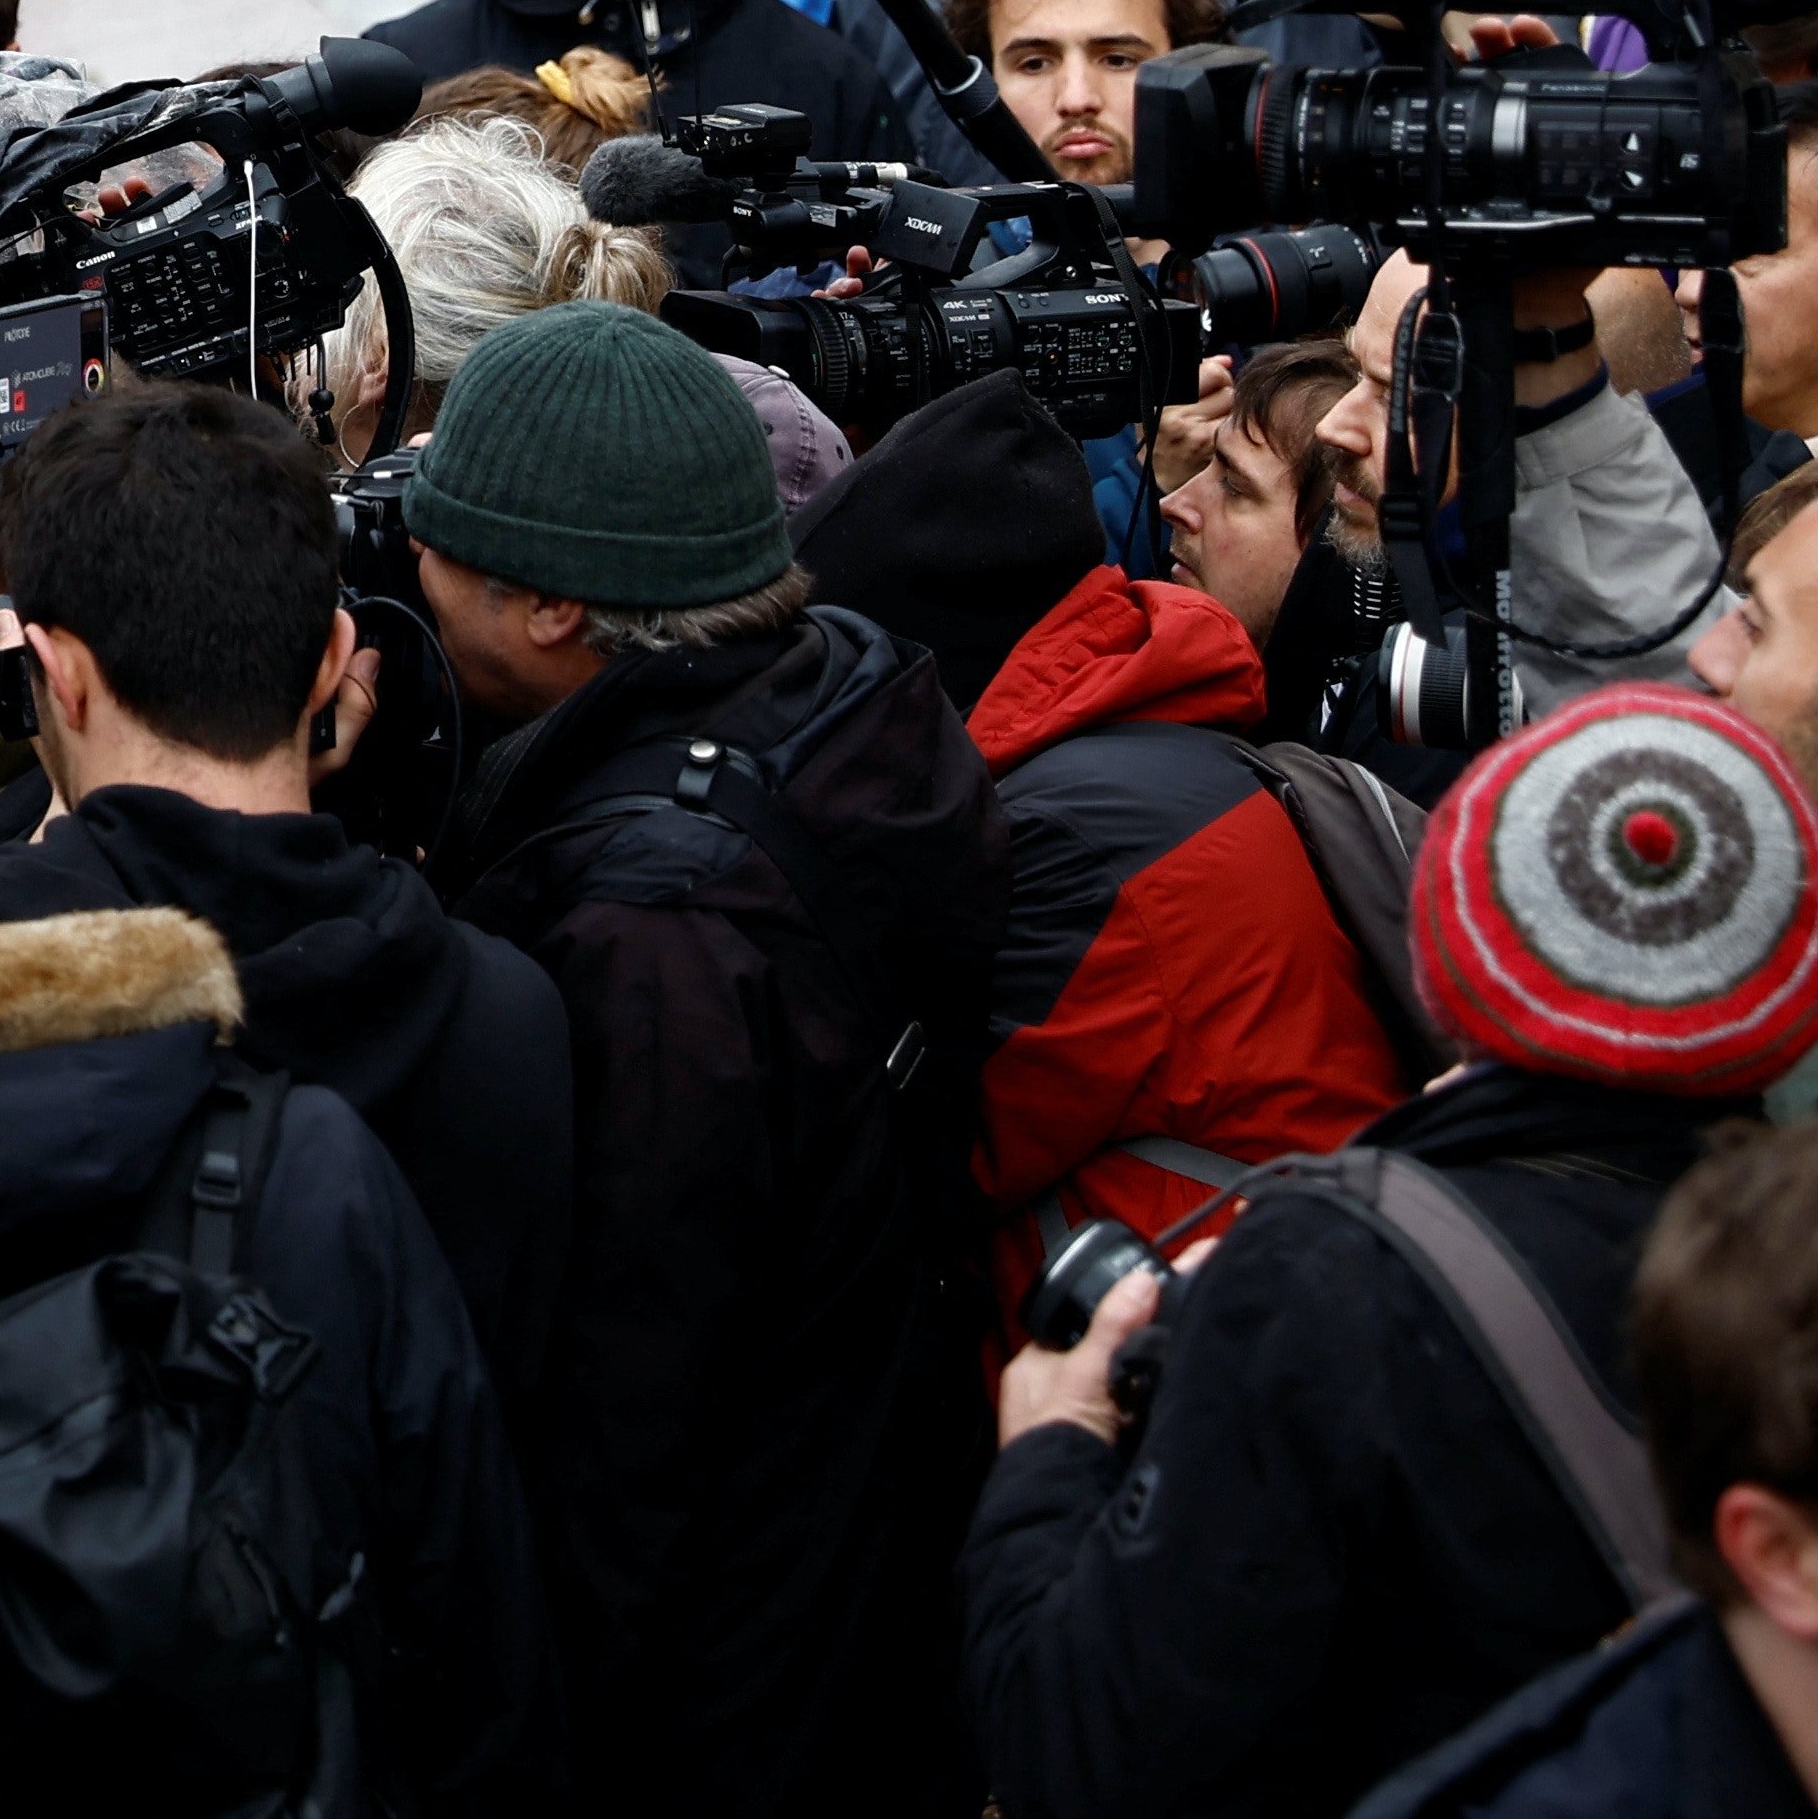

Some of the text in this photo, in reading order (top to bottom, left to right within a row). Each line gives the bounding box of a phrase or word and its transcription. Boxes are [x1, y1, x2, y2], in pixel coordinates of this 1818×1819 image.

[733, 205, 753, 217] SONY
[904, 216, 943, 236] XDCAM
[75, 250, 116, 270] Canon
[943, 300, 968, 309] 4K
